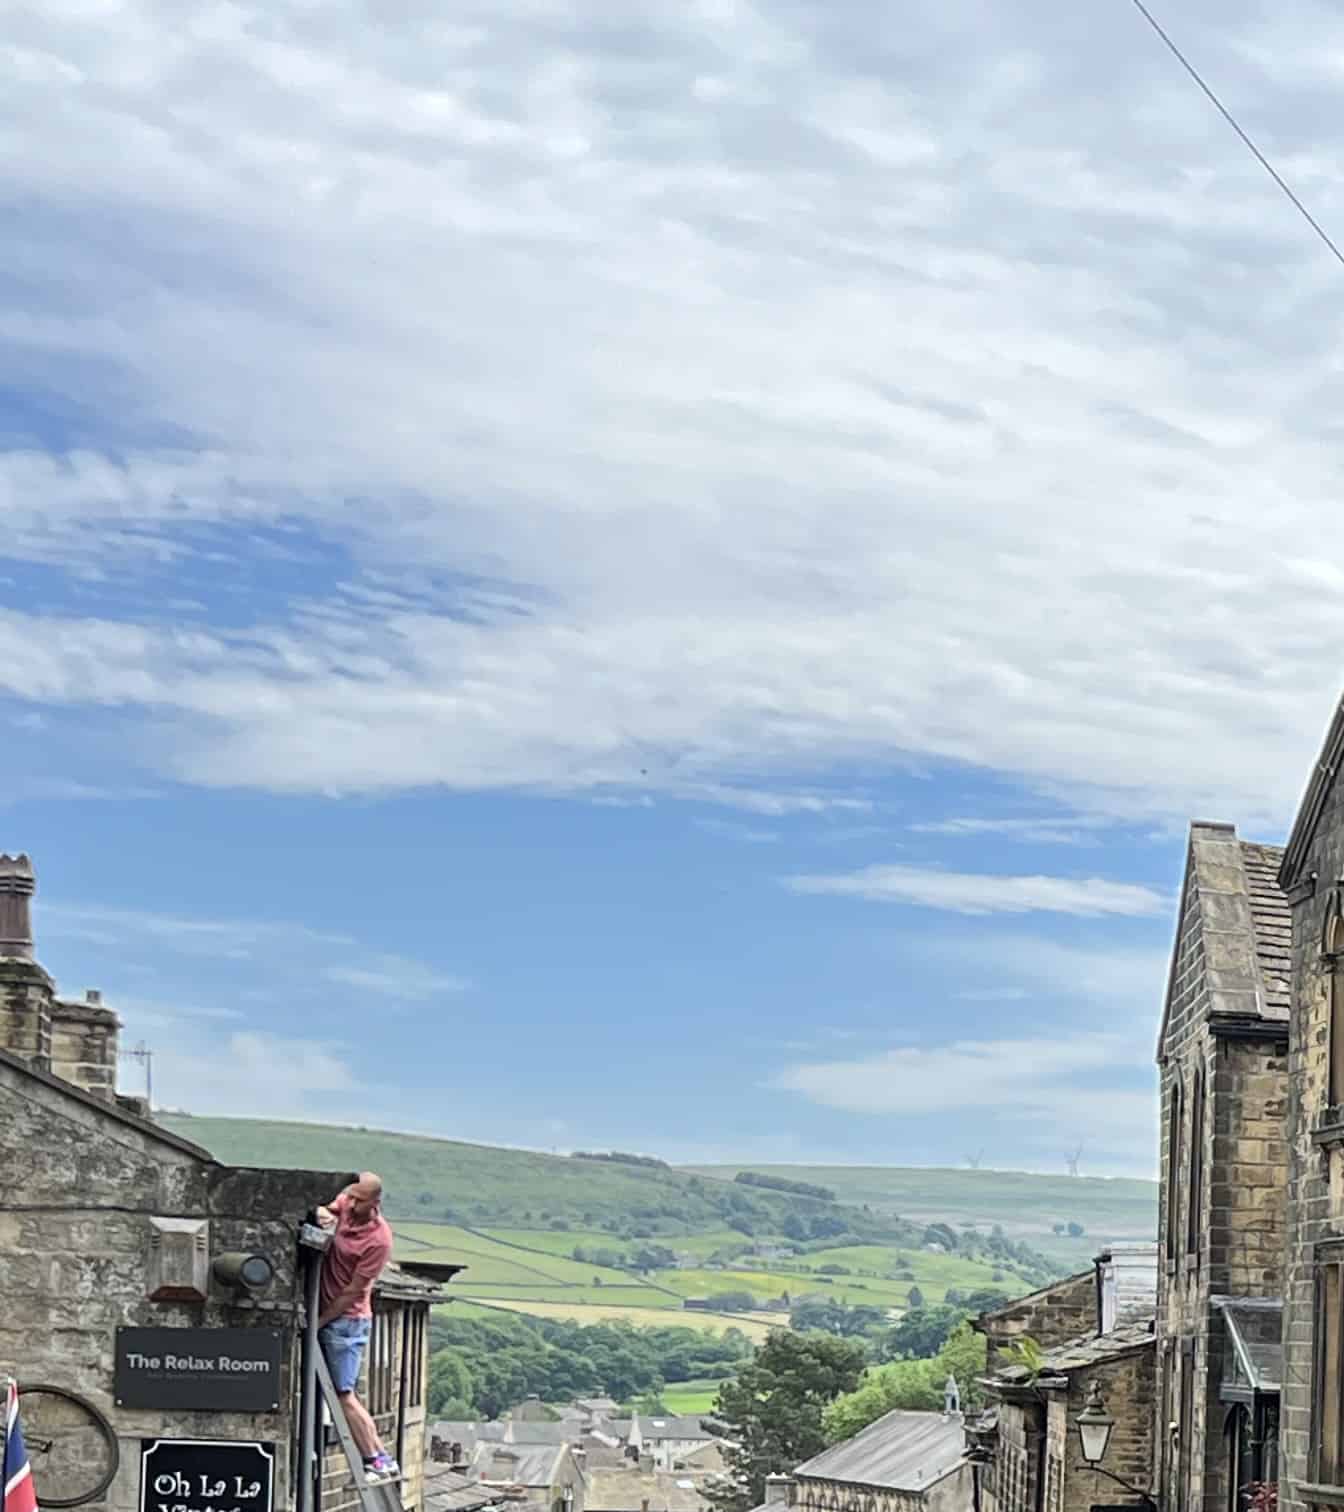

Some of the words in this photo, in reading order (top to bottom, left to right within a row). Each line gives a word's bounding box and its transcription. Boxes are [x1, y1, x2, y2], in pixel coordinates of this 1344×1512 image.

[126, 1353, 160, 1369] The
[165, 1355, 214, 1371] Relax
[218, 1356, 270, 1372] Room
[154, 1471, 191, 1497] Oh
[199, 1474, 226, 1497] La
[234, 1475, 261, 1498] La
